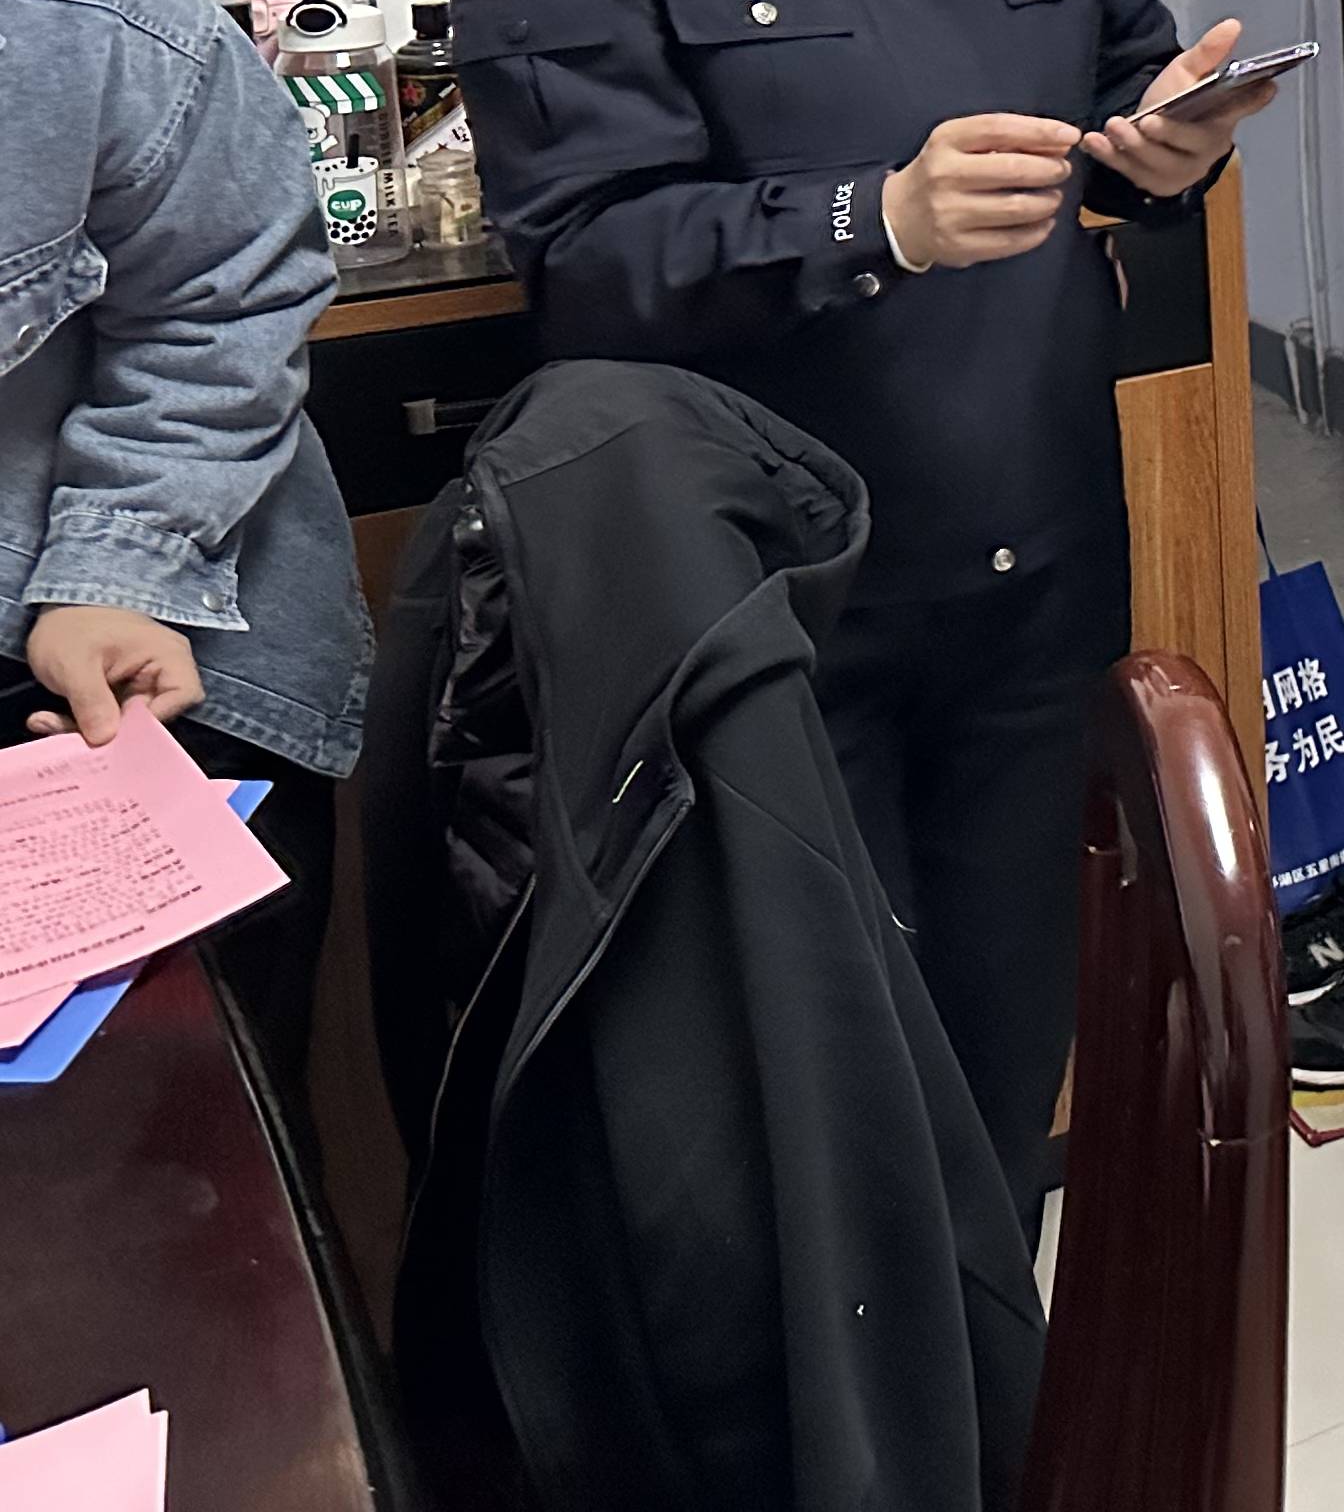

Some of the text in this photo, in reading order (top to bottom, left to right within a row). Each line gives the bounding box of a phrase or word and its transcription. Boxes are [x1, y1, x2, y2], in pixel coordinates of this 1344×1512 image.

[383, 172, 396, 207] MILK
[330, 199, 363, 211] CUP
[831, 181, 855, 241] POLICE
[386, 213, 399, 236] TEA
